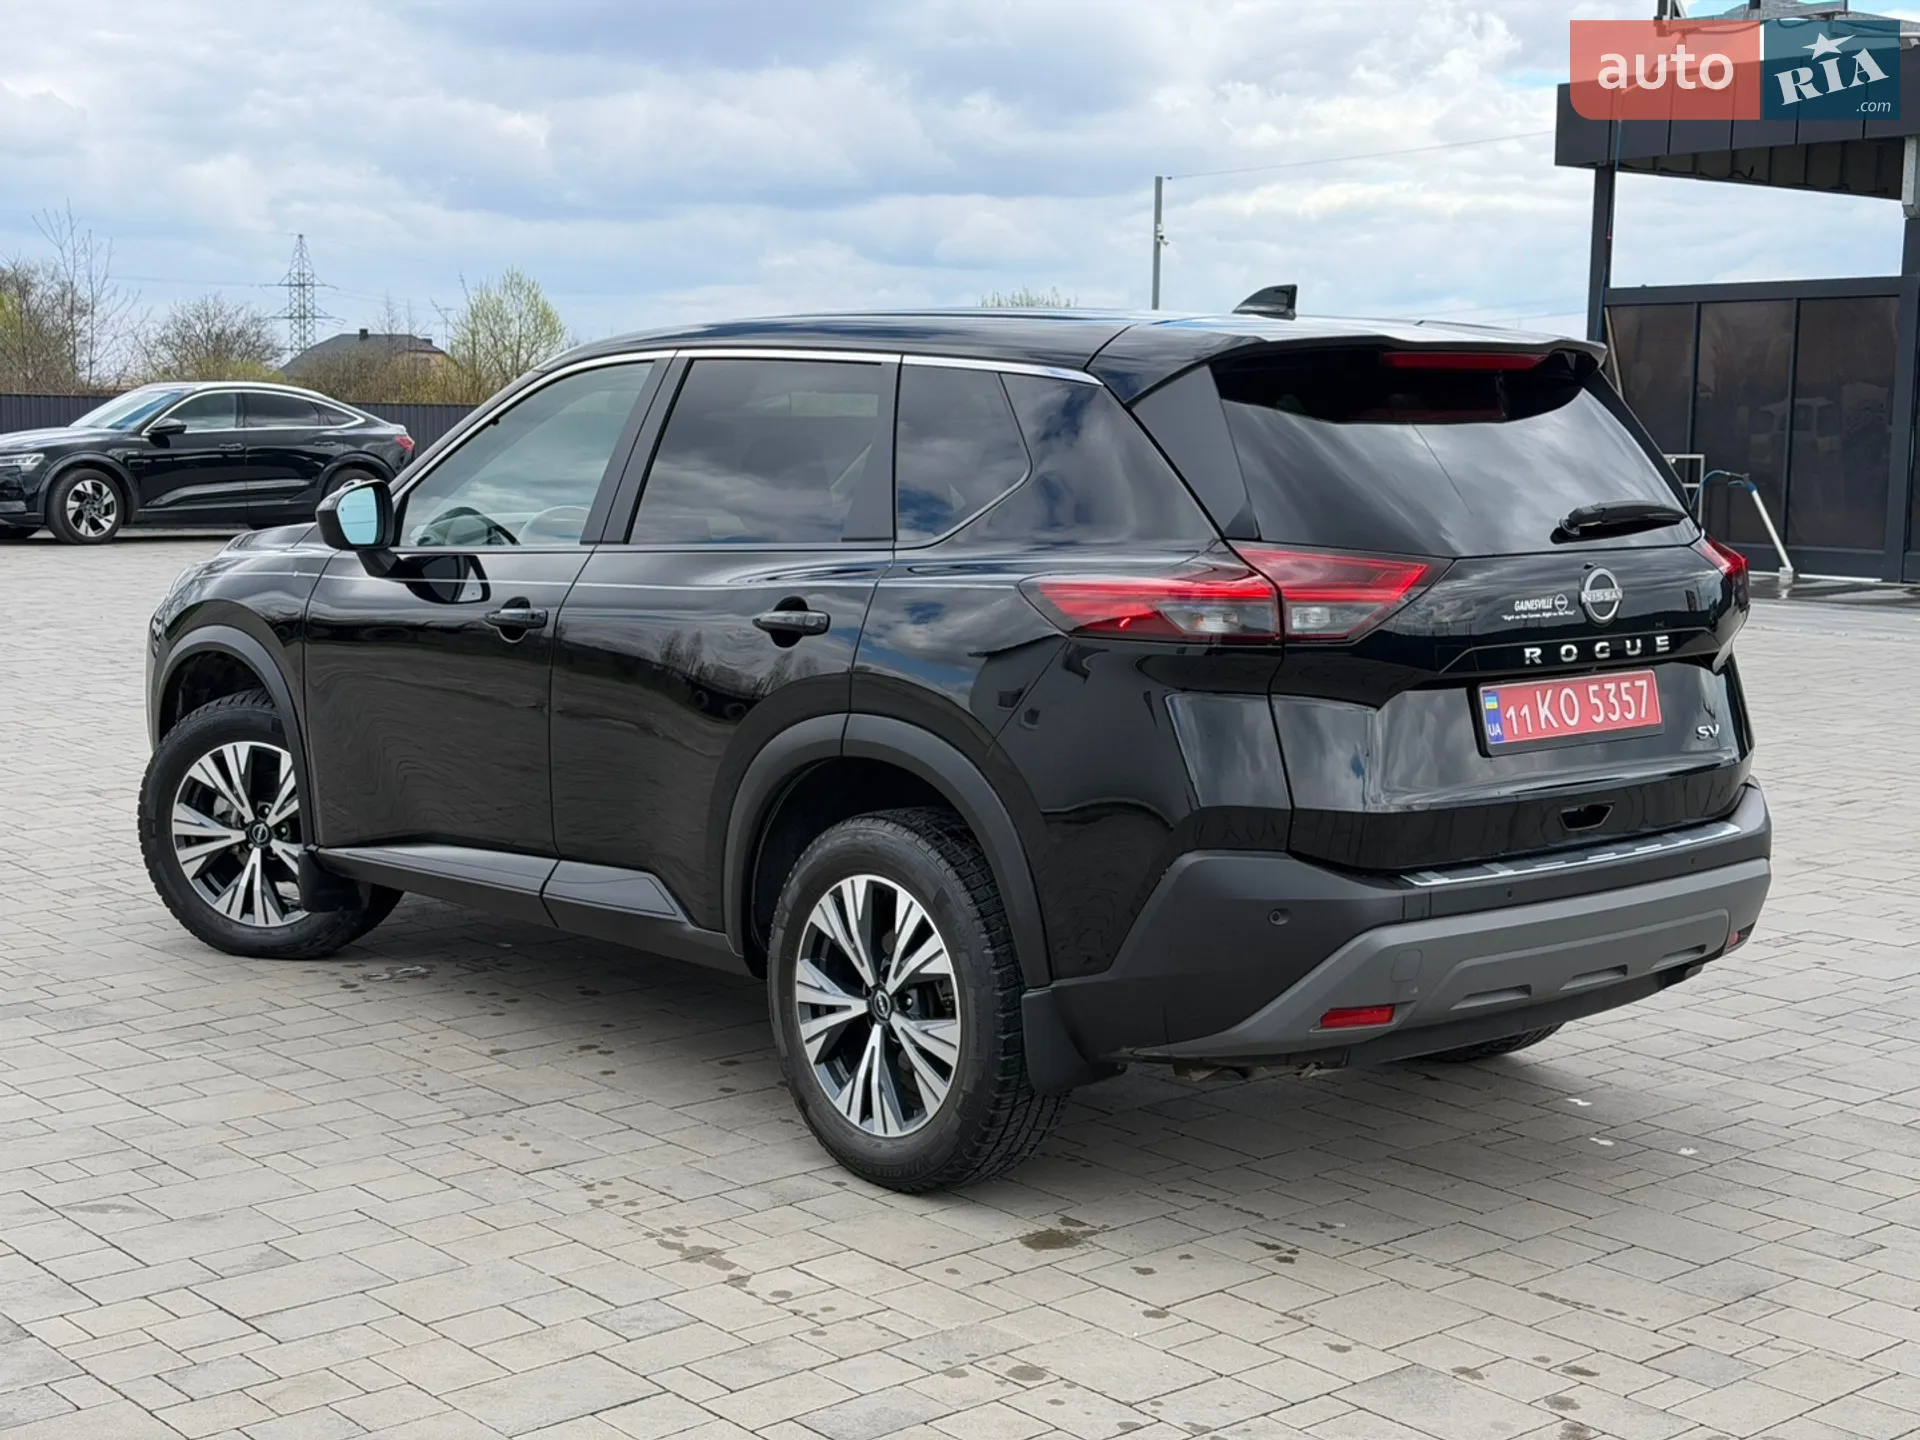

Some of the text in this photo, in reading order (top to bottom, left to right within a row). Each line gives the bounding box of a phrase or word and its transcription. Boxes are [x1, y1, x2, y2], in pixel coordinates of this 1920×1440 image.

[1581, 589, 1622, 603] NISSAN
[1514, 598, 1553, 612] GAINESVILLE
[1524, 635, 1670, 665] ROGUE
[1587, 680, 1648, 724] 5357
[1488, 722, 1502, 737] UA
[1696, 724, 1720, 740] SV
